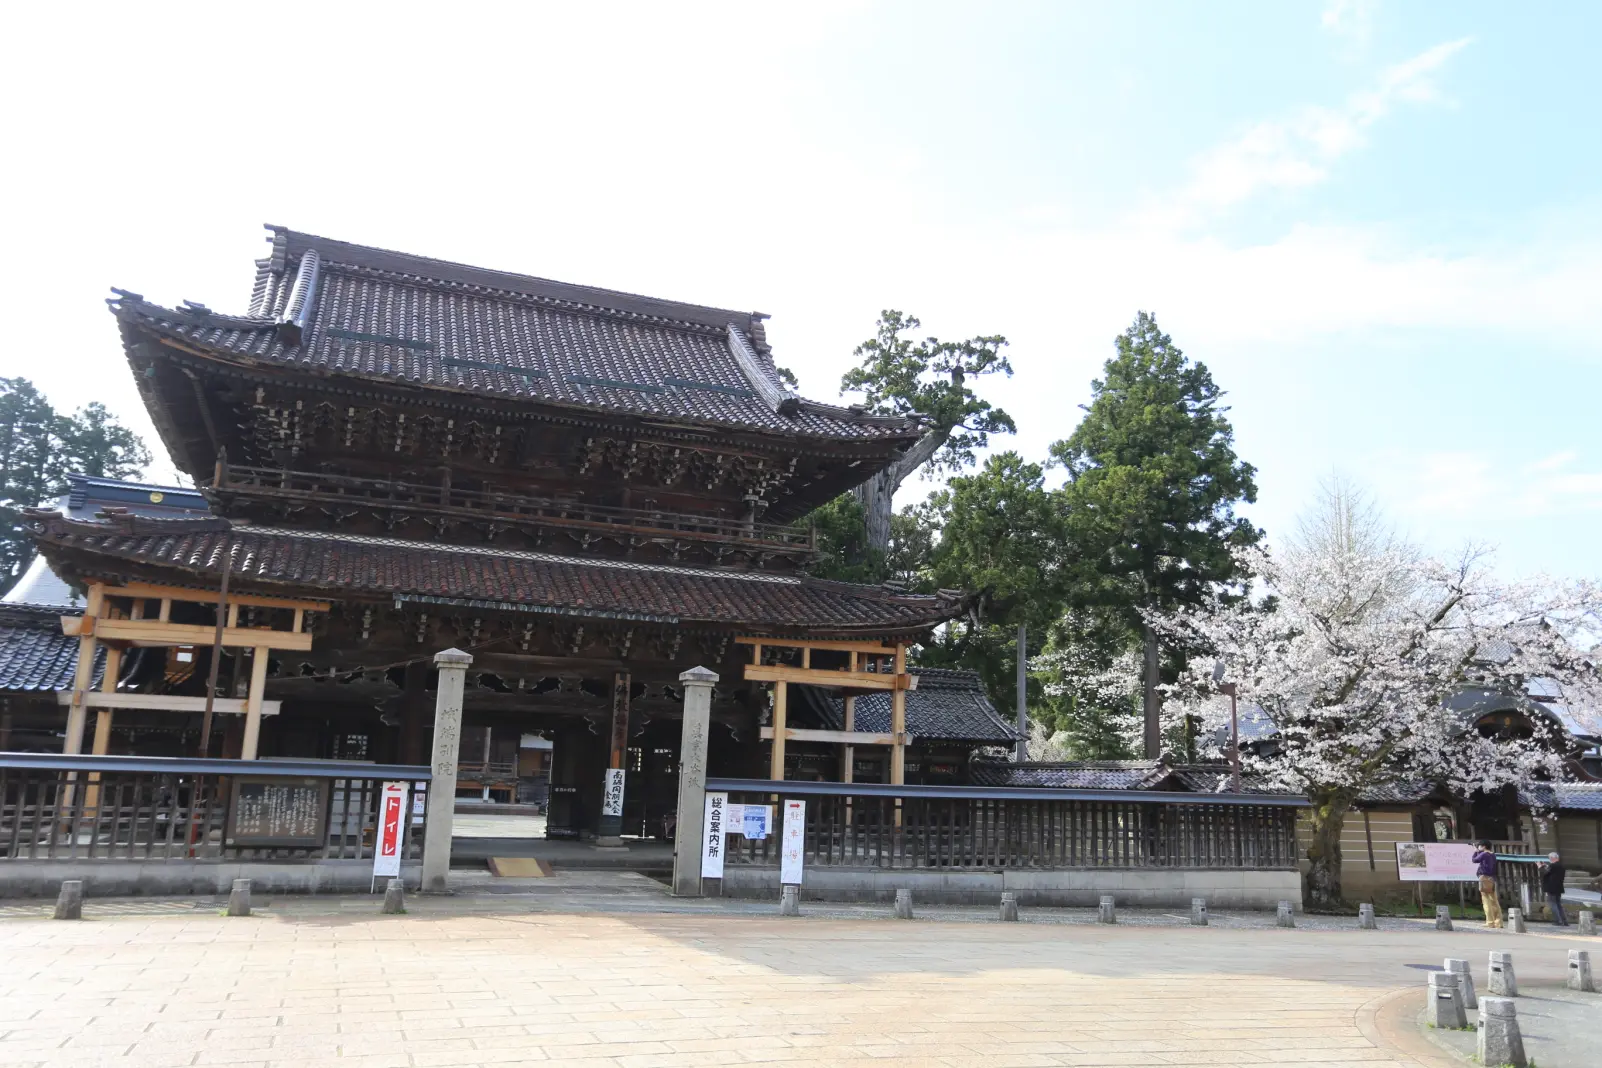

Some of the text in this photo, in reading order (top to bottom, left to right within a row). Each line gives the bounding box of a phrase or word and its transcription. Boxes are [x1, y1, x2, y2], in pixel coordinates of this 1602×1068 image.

[384, 800, 398, 854] トイレ
[708, 797, 722, 857] 総合案内所
[789, 811, 800, 860] 駐車場
